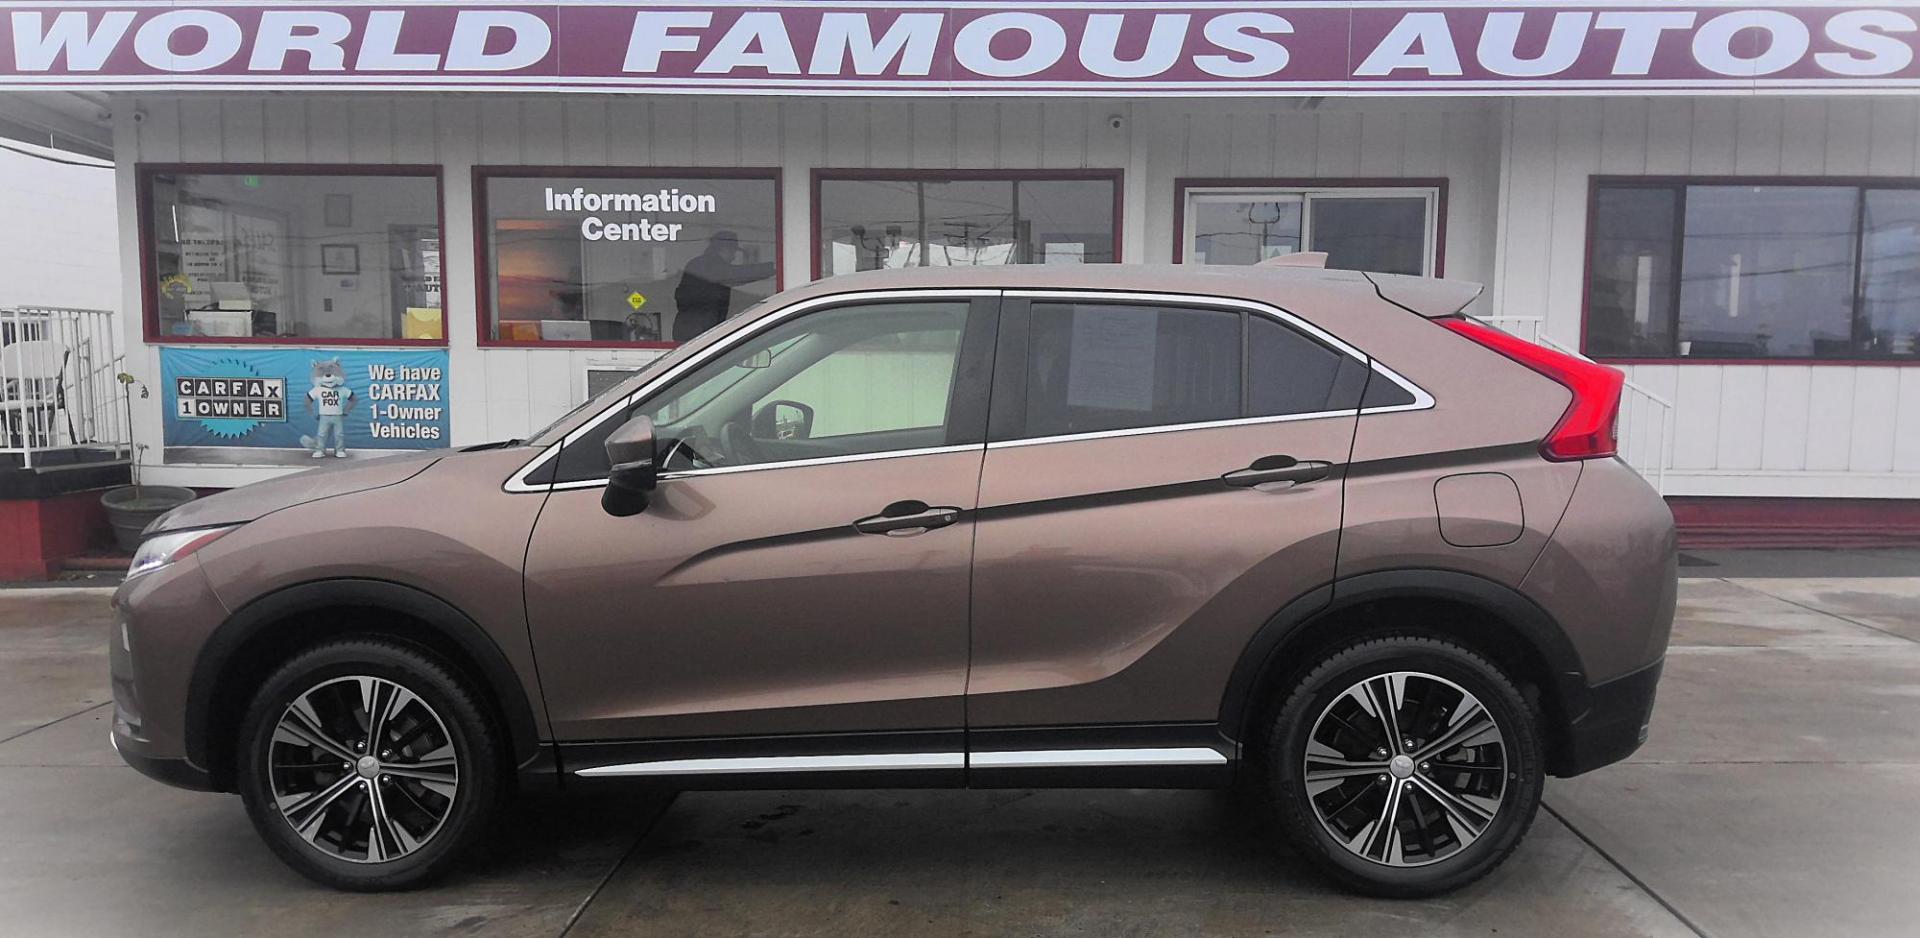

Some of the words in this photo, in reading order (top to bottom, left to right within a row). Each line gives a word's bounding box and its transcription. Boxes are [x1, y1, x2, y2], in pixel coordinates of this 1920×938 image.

[11, 9, 552, 72] WORLD
[622, 11, 1294, 78] FAMOUS
[1353, 9, 1915, 77] AUTOS
[545, 187, 716, 213] Information
[581, 216, 683, 242] Center
[368, 364, 395, 381] We
[400, 365, 441, 381] have
[179, 379, 281, 399] CARFAX
[321, 390, 340, 399] CAR
[369, 384, 441, 401] CARFAX
[181, 400, 193, 415] 1
[198, 400, 281, 416] OWNER
[322, 398, 339, 408] FOX
[370, 404, 442, 420] 1-Owner
[370, 422, 441, 440] Vehicles
